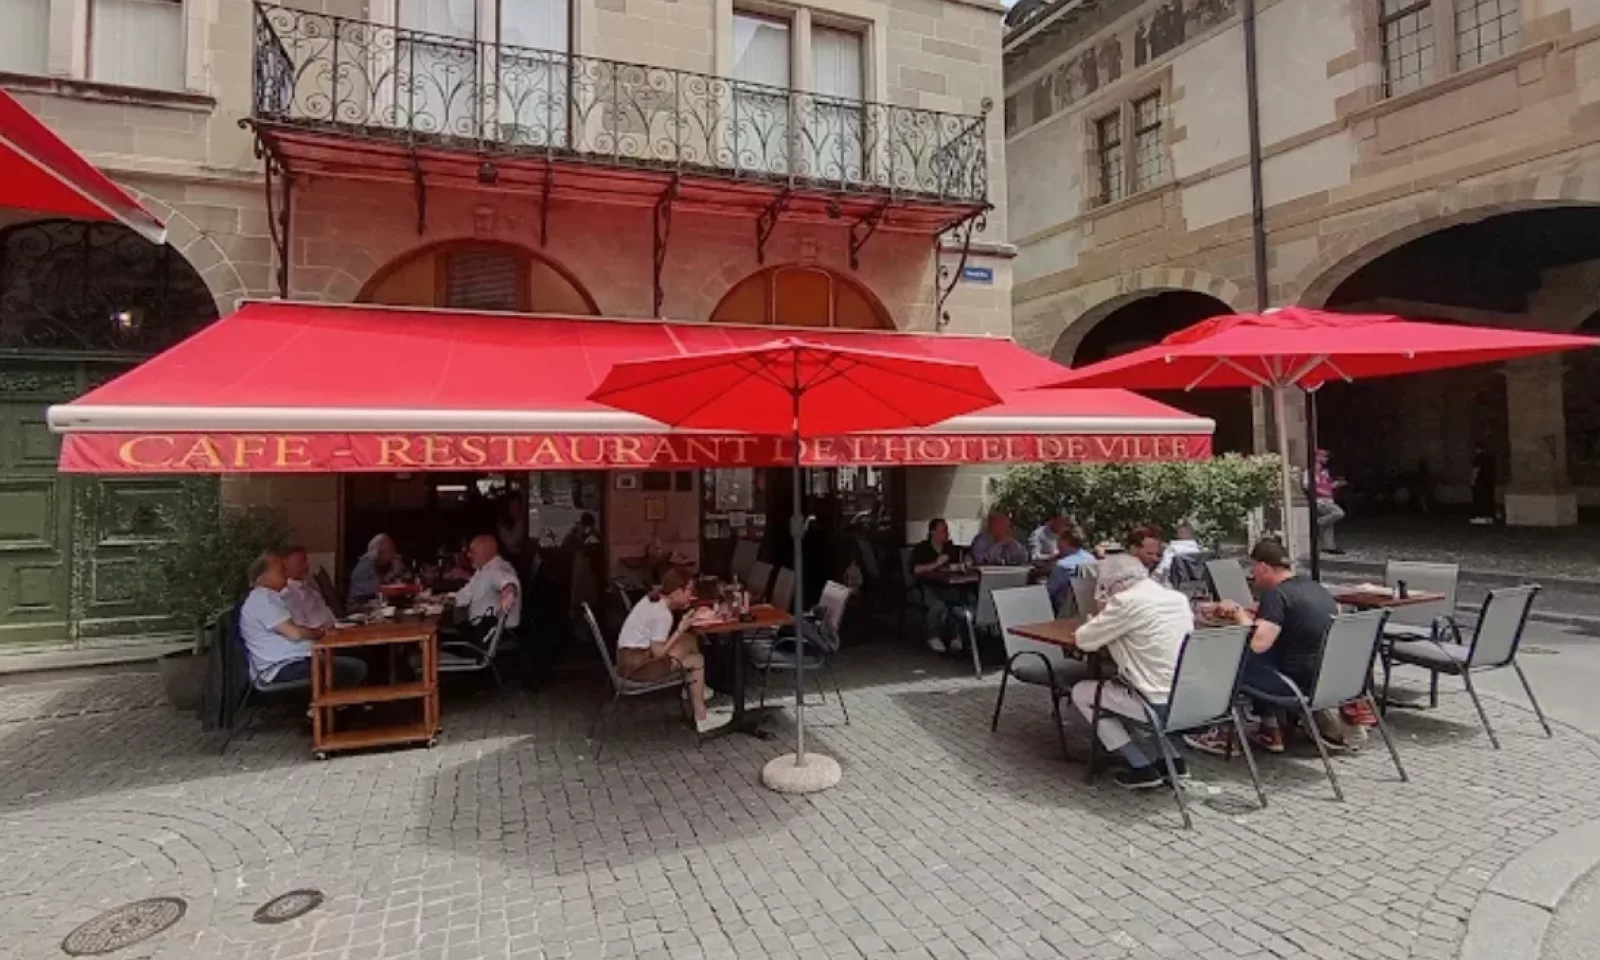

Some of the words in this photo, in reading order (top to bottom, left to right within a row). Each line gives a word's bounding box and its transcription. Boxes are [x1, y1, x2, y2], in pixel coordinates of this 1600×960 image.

[118, 436, 312, 467] CAFE
[375, 435, 758, 466] RESTAURANT
[772, 437, 837, 461] DE
[1036, 435, 1087, 459] DE
[1092, 436, 1189, 459] VILLE
